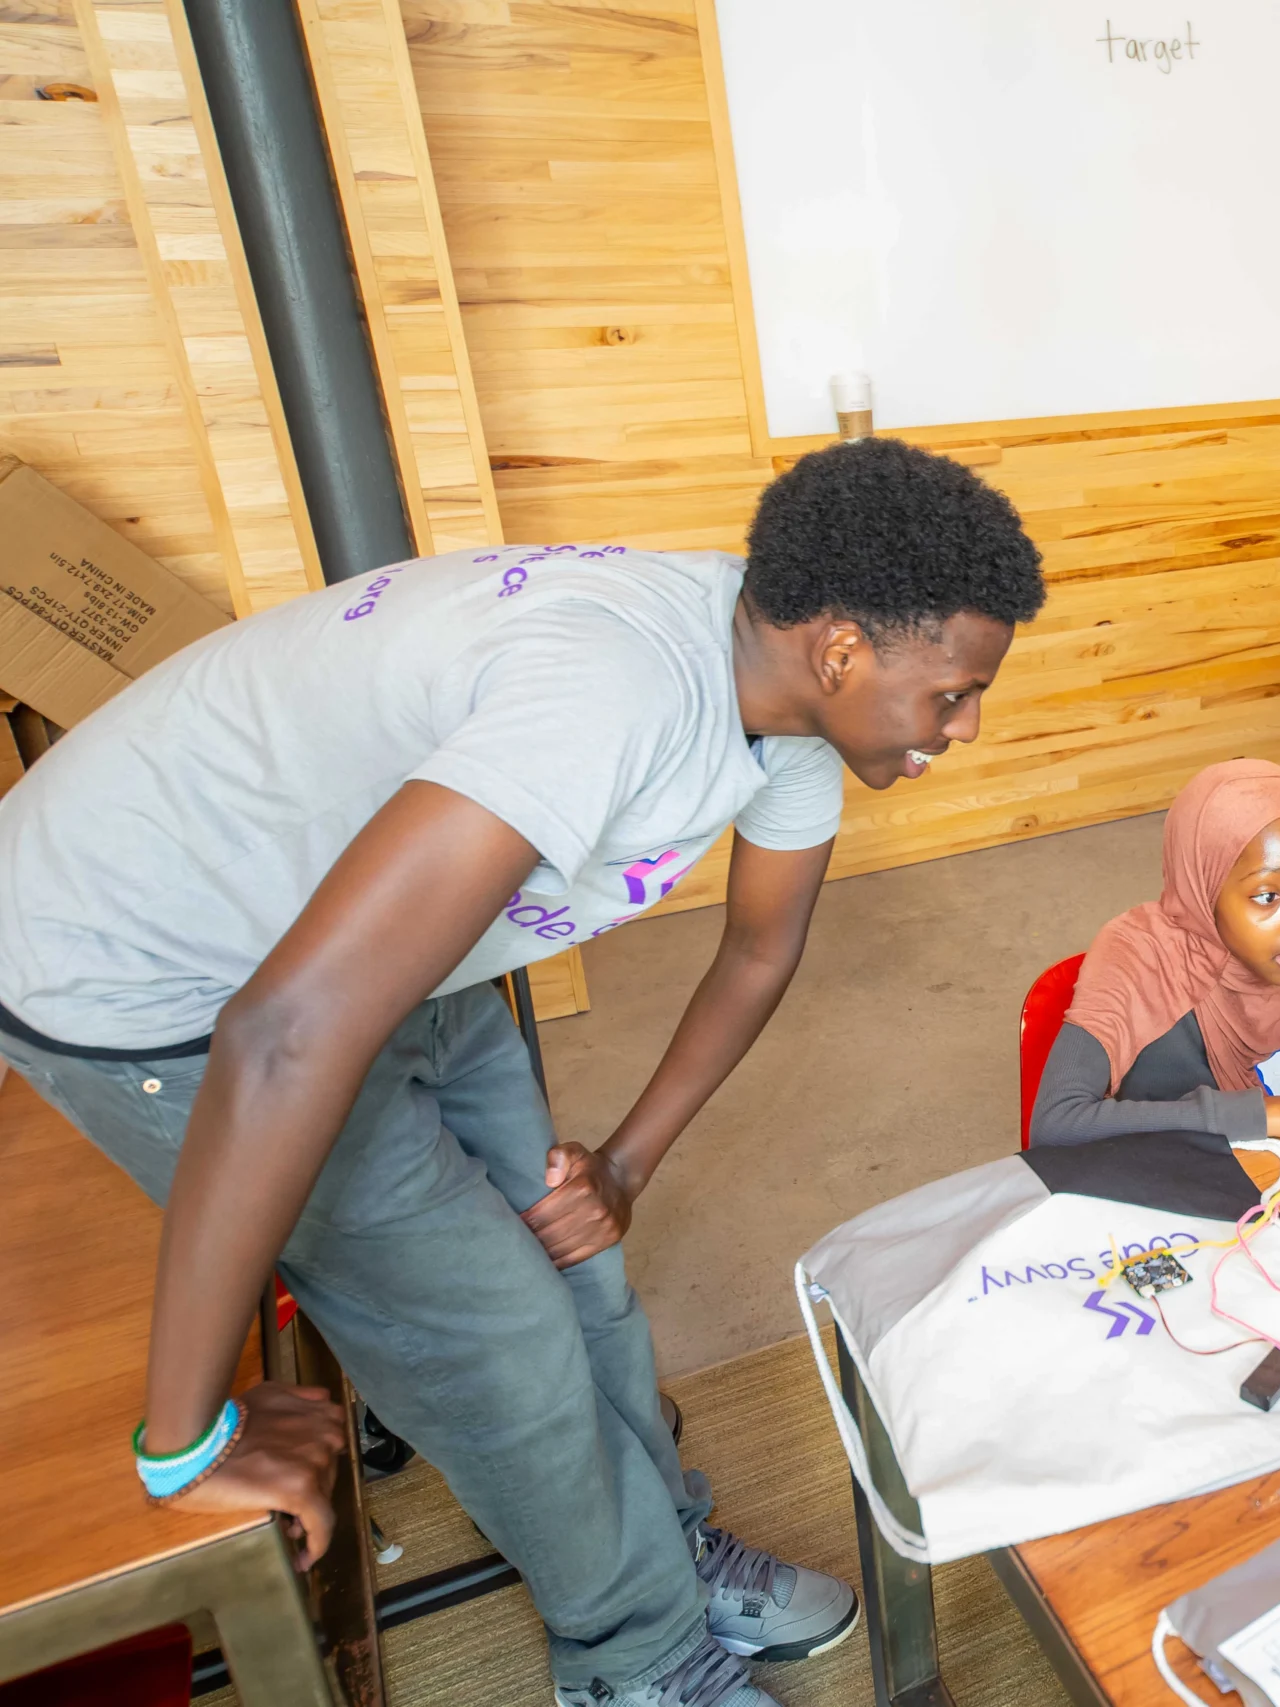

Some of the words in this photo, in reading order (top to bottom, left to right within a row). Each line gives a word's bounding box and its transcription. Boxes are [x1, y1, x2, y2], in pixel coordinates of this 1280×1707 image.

[1096, 19, 1200, 74] target
[80, 558, 113, 586] CHINA
[8, 586, 32, 606] PCS
[112, 582, 126, 595] IN
[125, 591, 157, 616] MADE
[29, 585, 89, 630] QTY-21PCS
[81, 607, 132, 643] PO#-3377
[89, 626, 124, 653] INNER
[69, 627, 116, 662] MASTER
[980, 1257, 1096, 1296] Savvy
